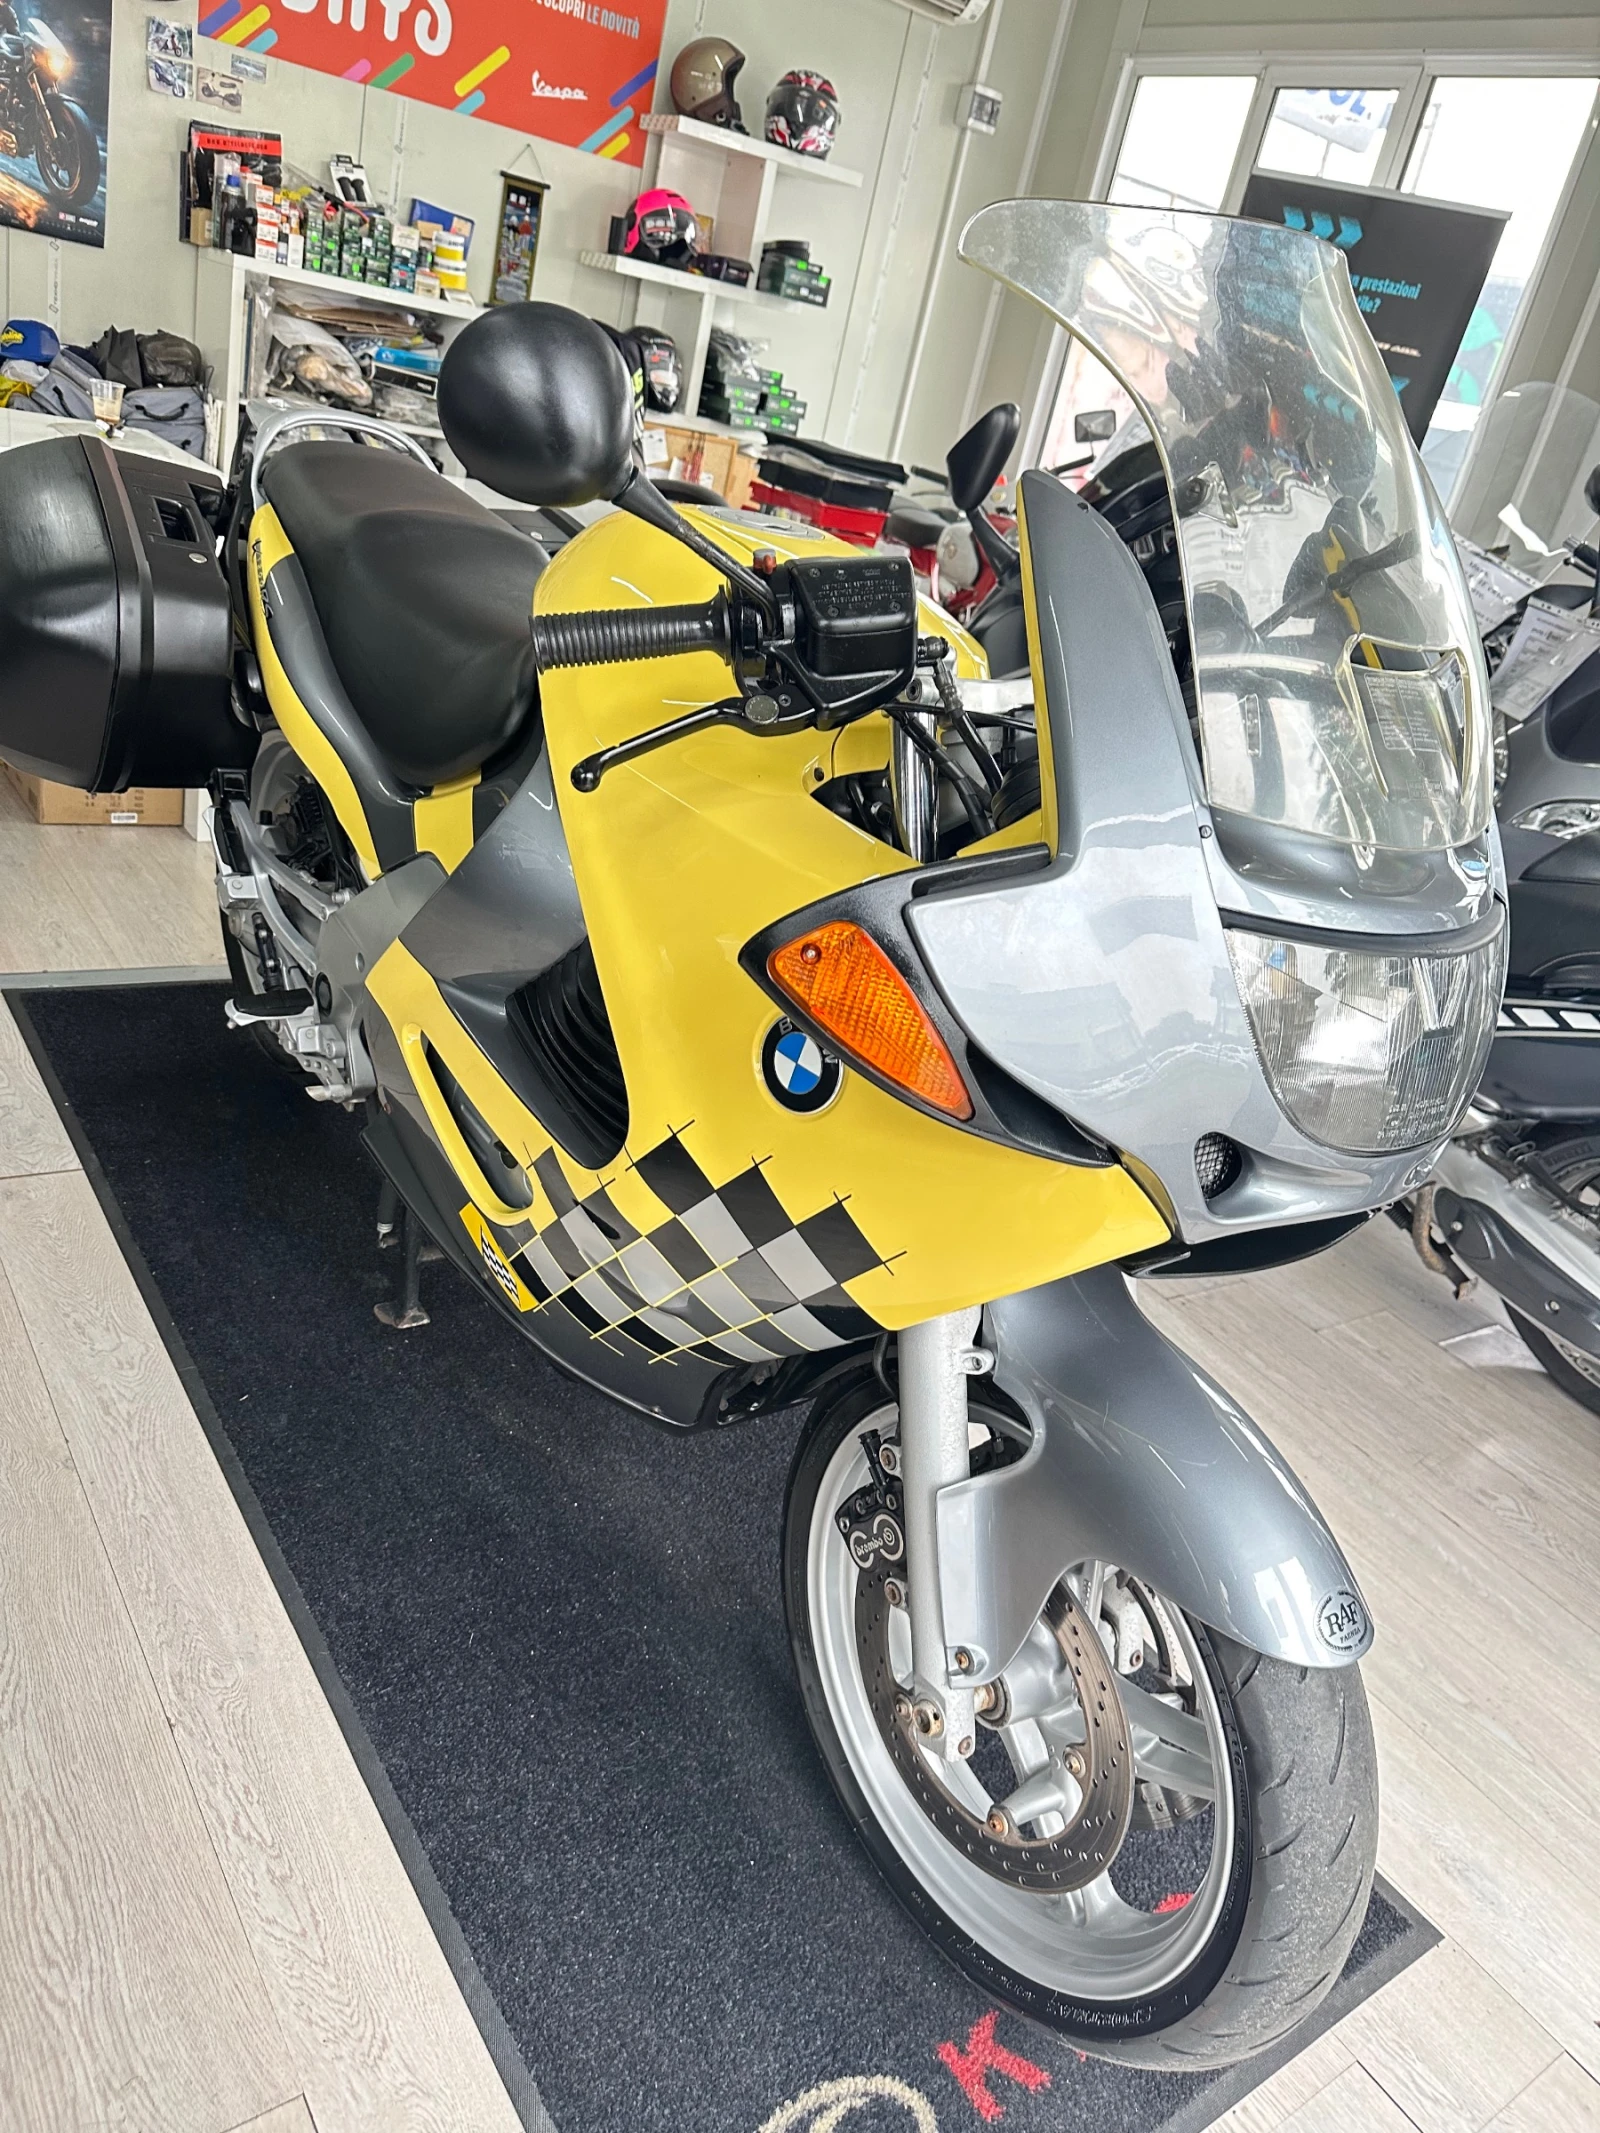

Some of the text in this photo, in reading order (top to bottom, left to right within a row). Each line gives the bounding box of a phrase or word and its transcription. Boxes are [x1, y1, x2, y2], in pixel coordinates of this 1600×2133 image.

[586, 3, 600, 25] LE
[600, 9, 640, 40] NOVITÀ
[531, 70, 588, 100] Vespa
[1359, 276, 1422, 300] prestazioni
[1357, 294, 1382, 314] tile?
[855, 1537, 883, 1556] brembo
[1324, 1601, 1357, 1637] RAF
